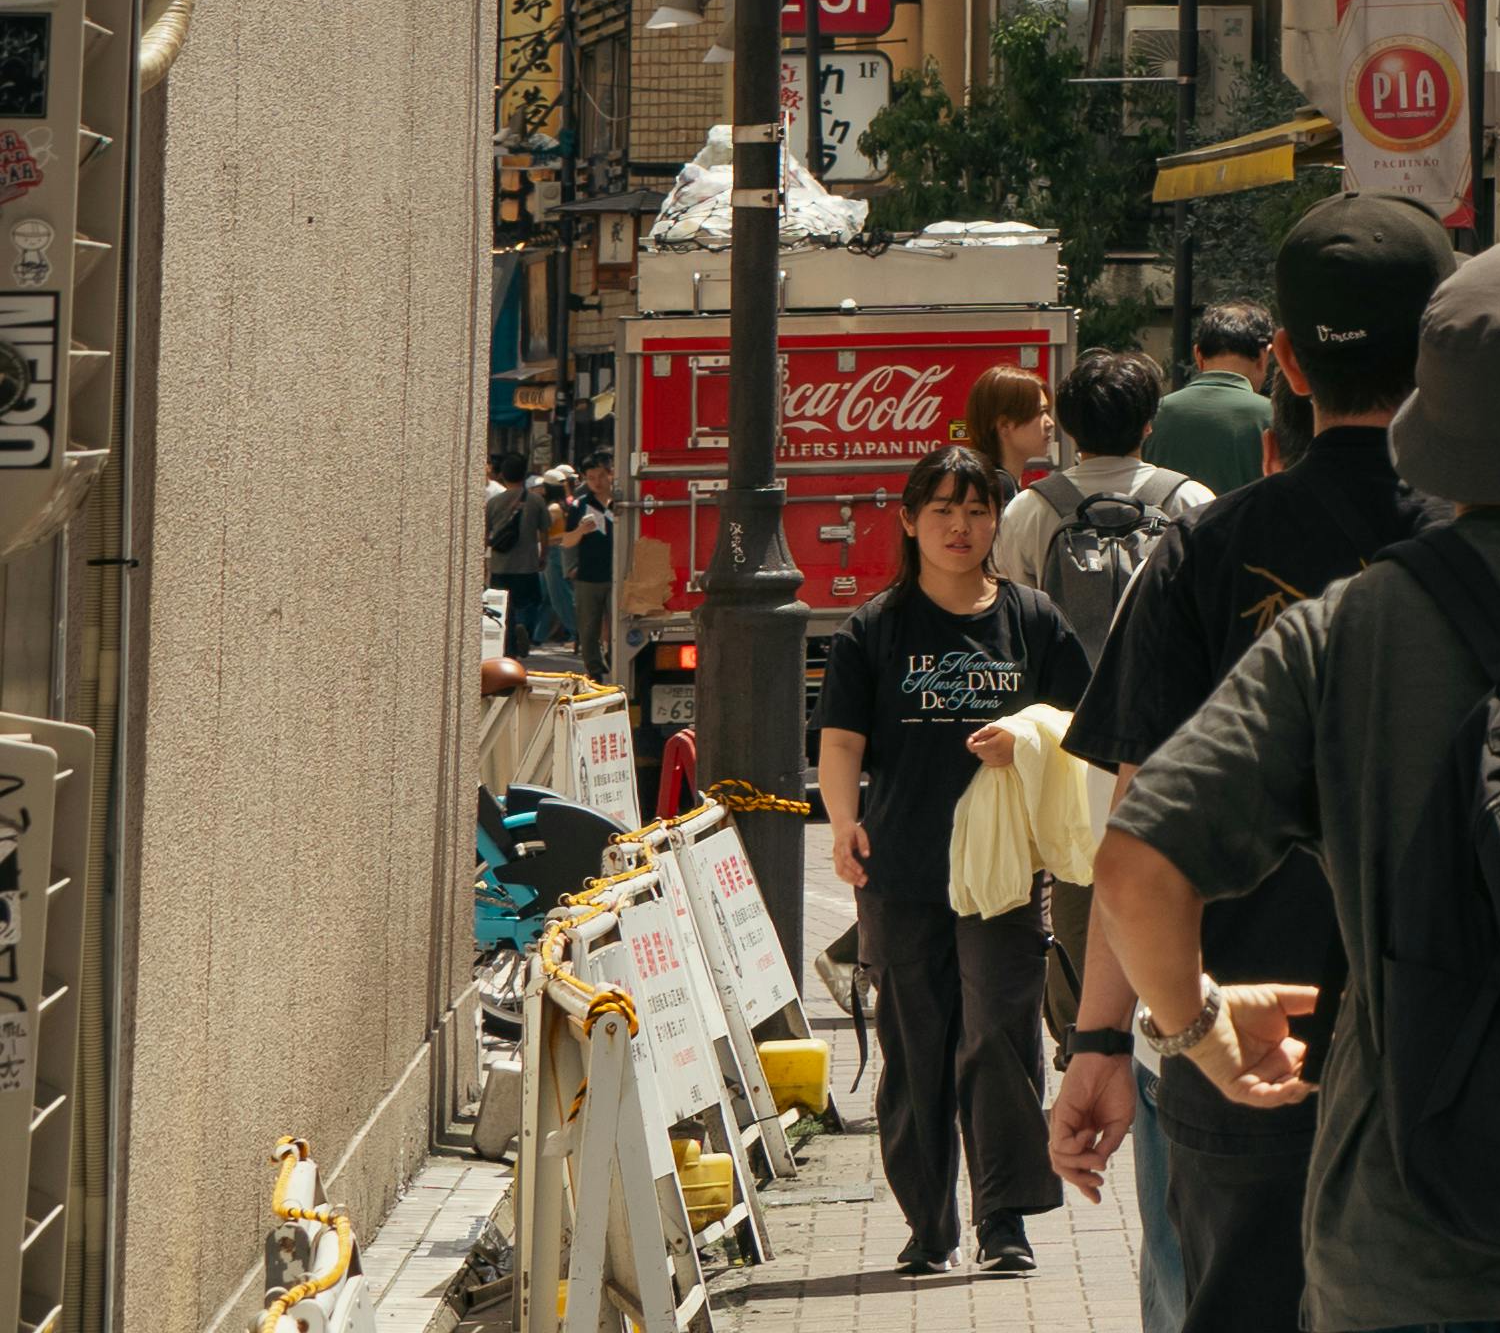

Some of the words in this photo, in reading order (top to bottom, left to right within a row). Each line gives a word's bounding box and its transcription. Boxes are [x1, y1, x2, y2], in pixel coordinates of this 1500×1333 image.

[859, 61, 880, 79] 1F
[1372, 69, 1437, 110] PIA
[1373, 158, 1441, 170] PACHINKO
[844, 441, 903, 459] JAPAN
[908, 654, 936, 673] LE
[967, 669, 1022, 692] D'ART
[920, 691, 946, 710] De
[945, 687, 1003, 711] Paris
